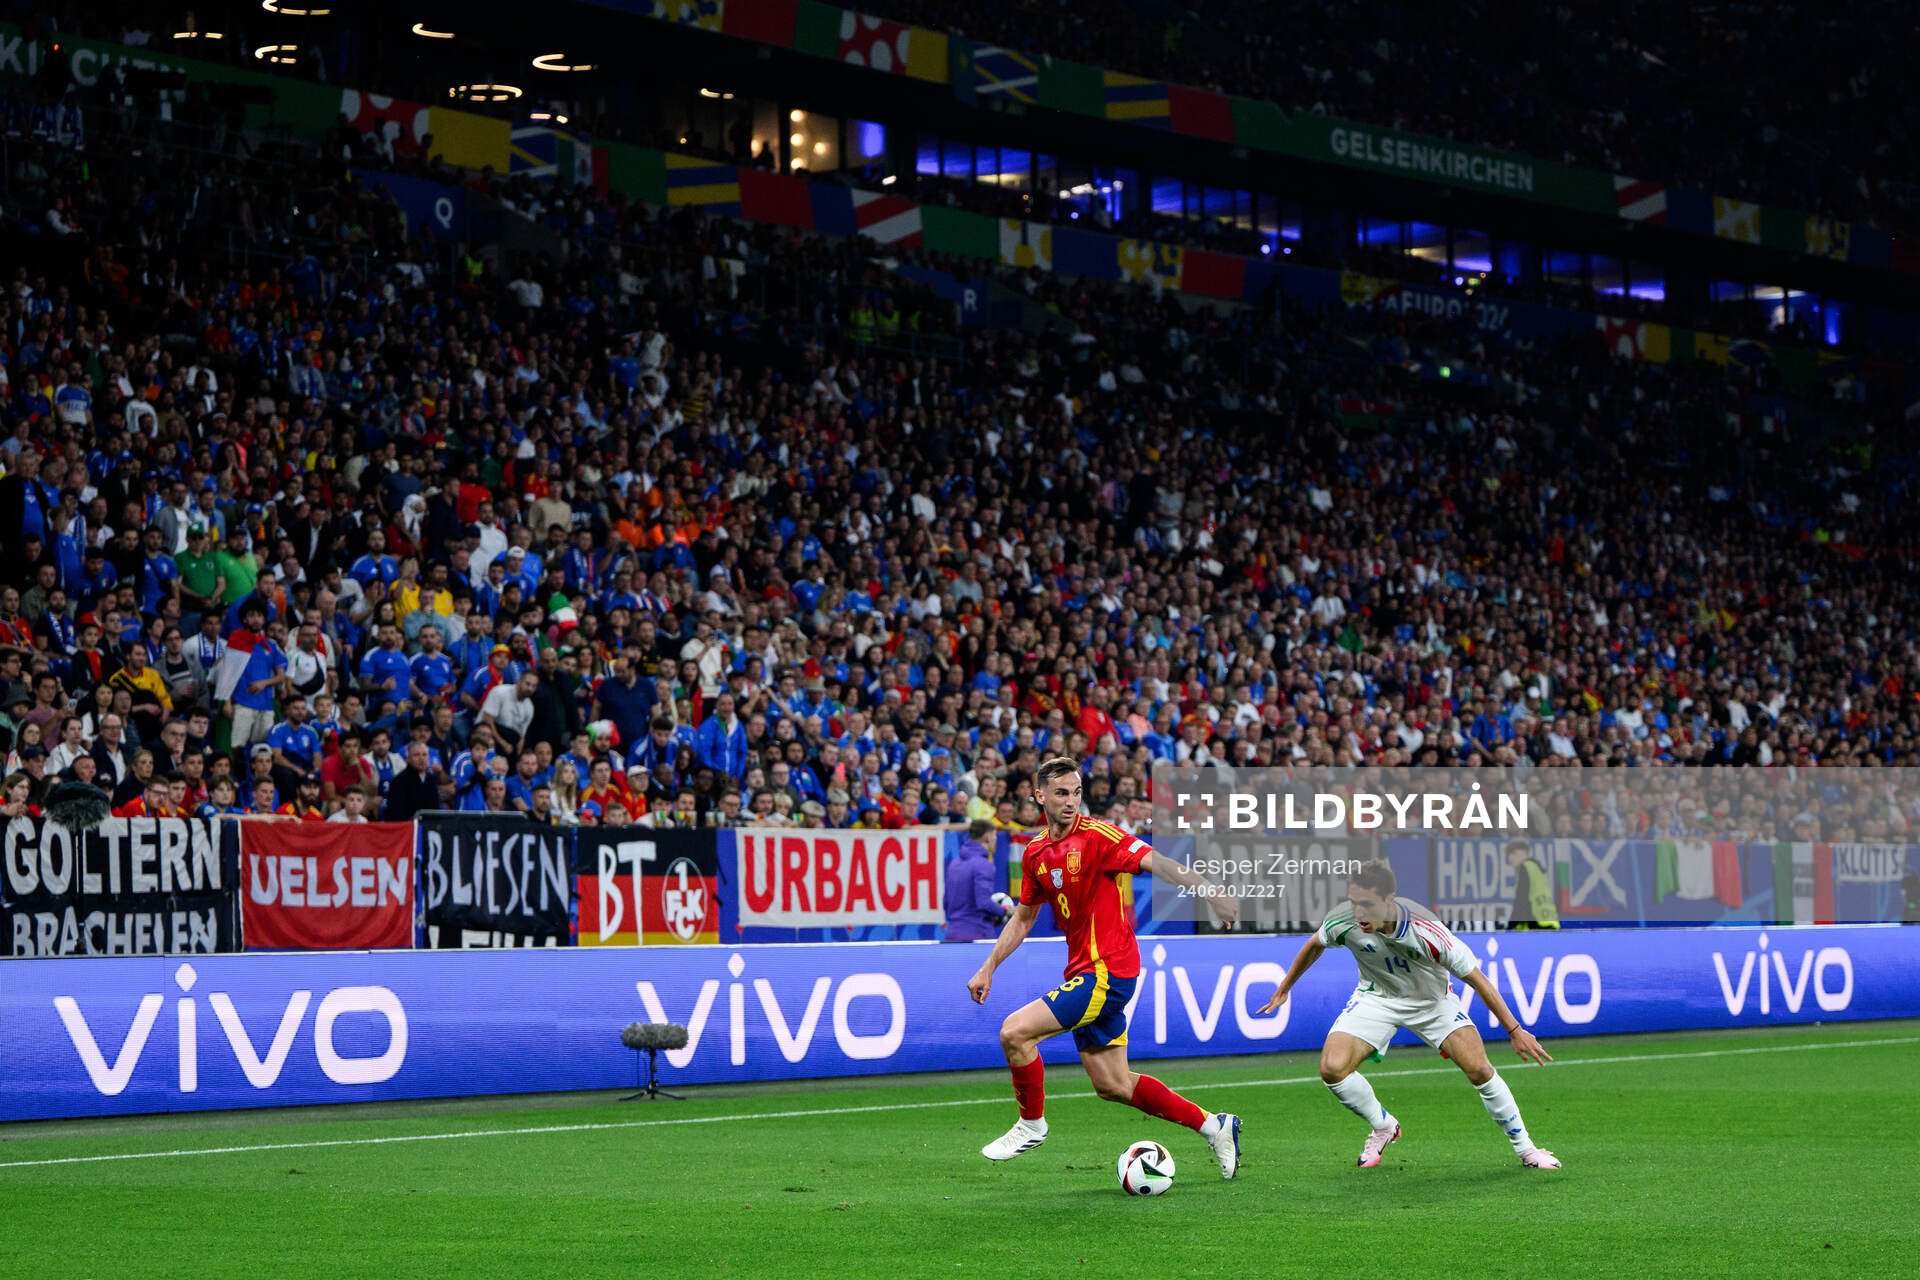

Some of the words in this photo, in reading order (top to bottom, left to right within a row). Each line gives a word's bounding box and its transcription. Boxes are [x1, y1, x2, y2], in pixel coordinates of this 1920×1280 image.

[1330, 126, 1534, 193] GELSENKIRCHEN
[435, 197, 453, 229] Q
[964, 288, 978, 312] R
[5, 815, 222, 895] GOLTERN
[248, 854, 409, 908] UELSEN
[744, 834, 938, 915] URBACH
[1437, 840, 1555, 900] HADEN
[598, 840, 657, 945] BT
[1057, 892, 1071, 919] 8
[1060, 976, 1084, 992] 8
[1384, 956, 1411, 974] 14
[1712, 931, 1854, 1016] vivo
[53, 963, 408, 1096] vivo
[635, 952, 906, 1068] vivo
